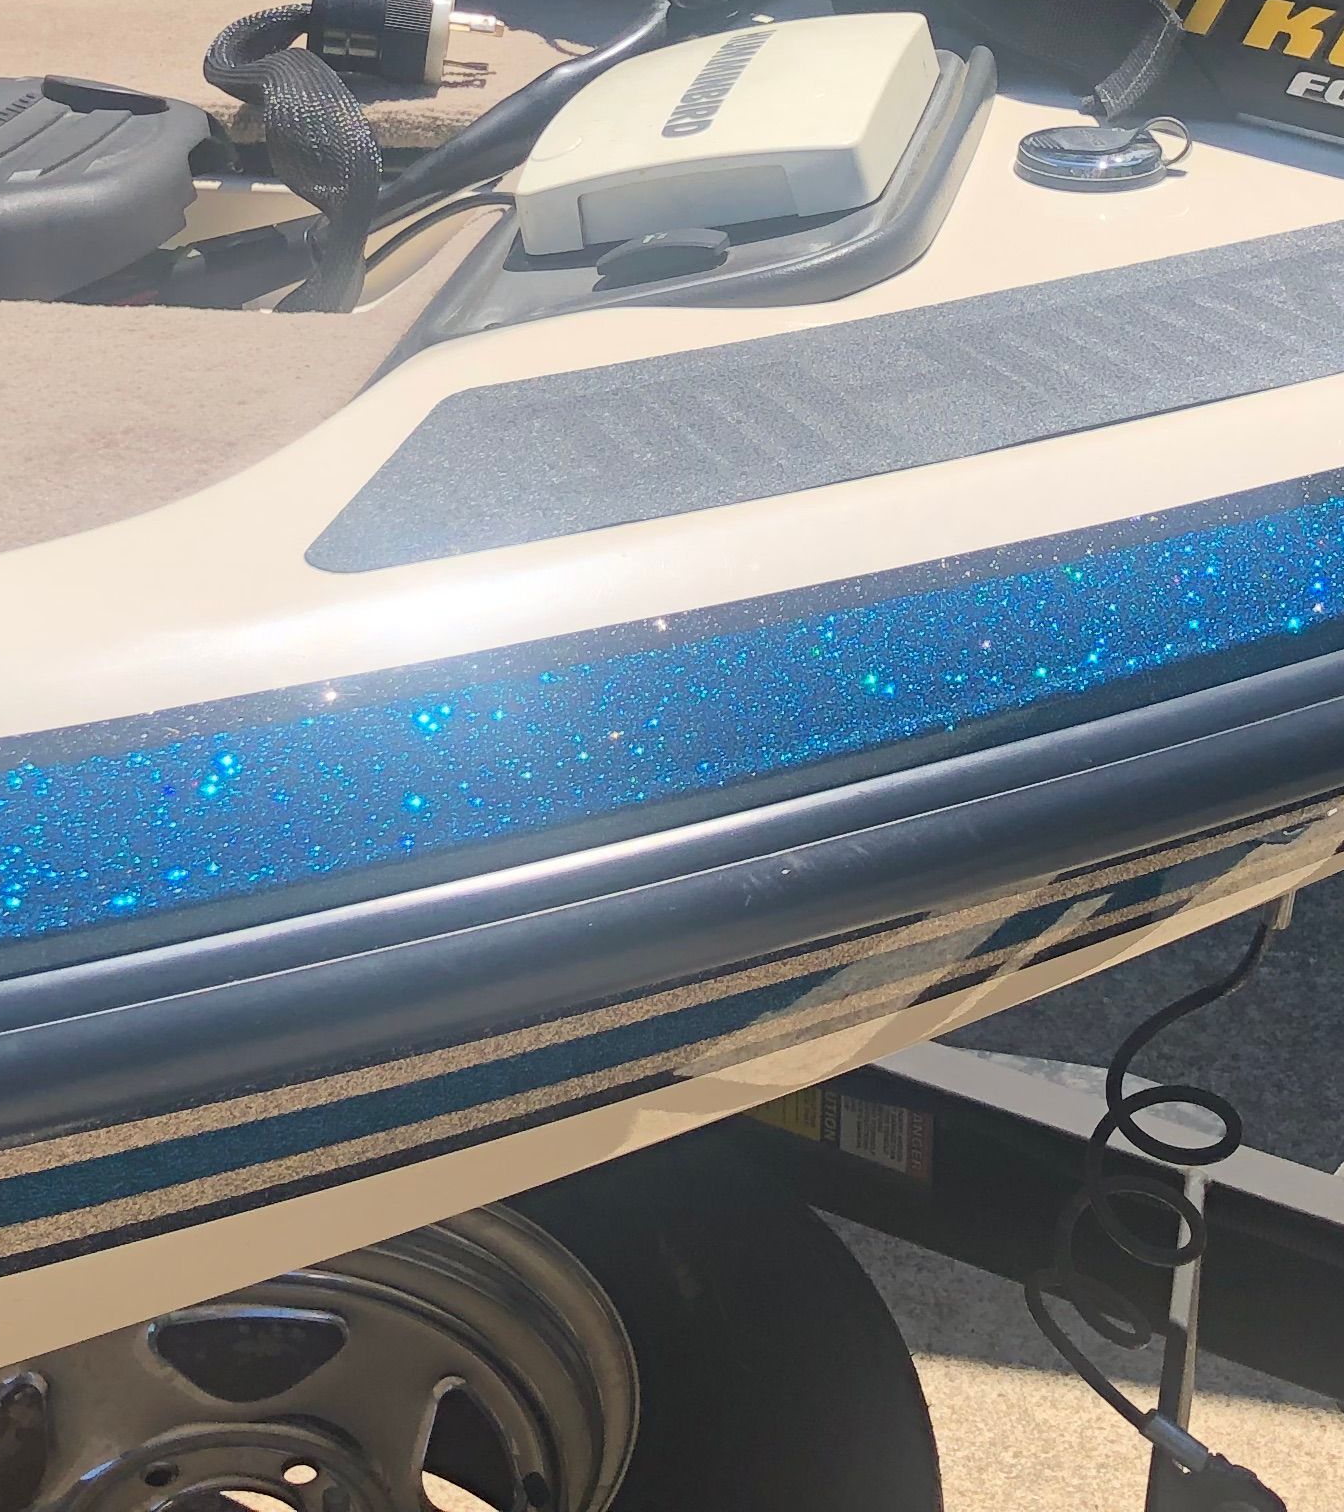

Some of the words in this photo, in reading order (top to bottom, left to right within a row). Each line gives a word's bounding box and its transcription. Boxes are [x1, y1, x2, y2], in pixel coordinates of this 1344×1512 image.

[661, 29, 778, 139] HUMMINBIRD
[824, 1089, 838, 1141] UTION
[910, 1111, 924, 1170] ANGER
